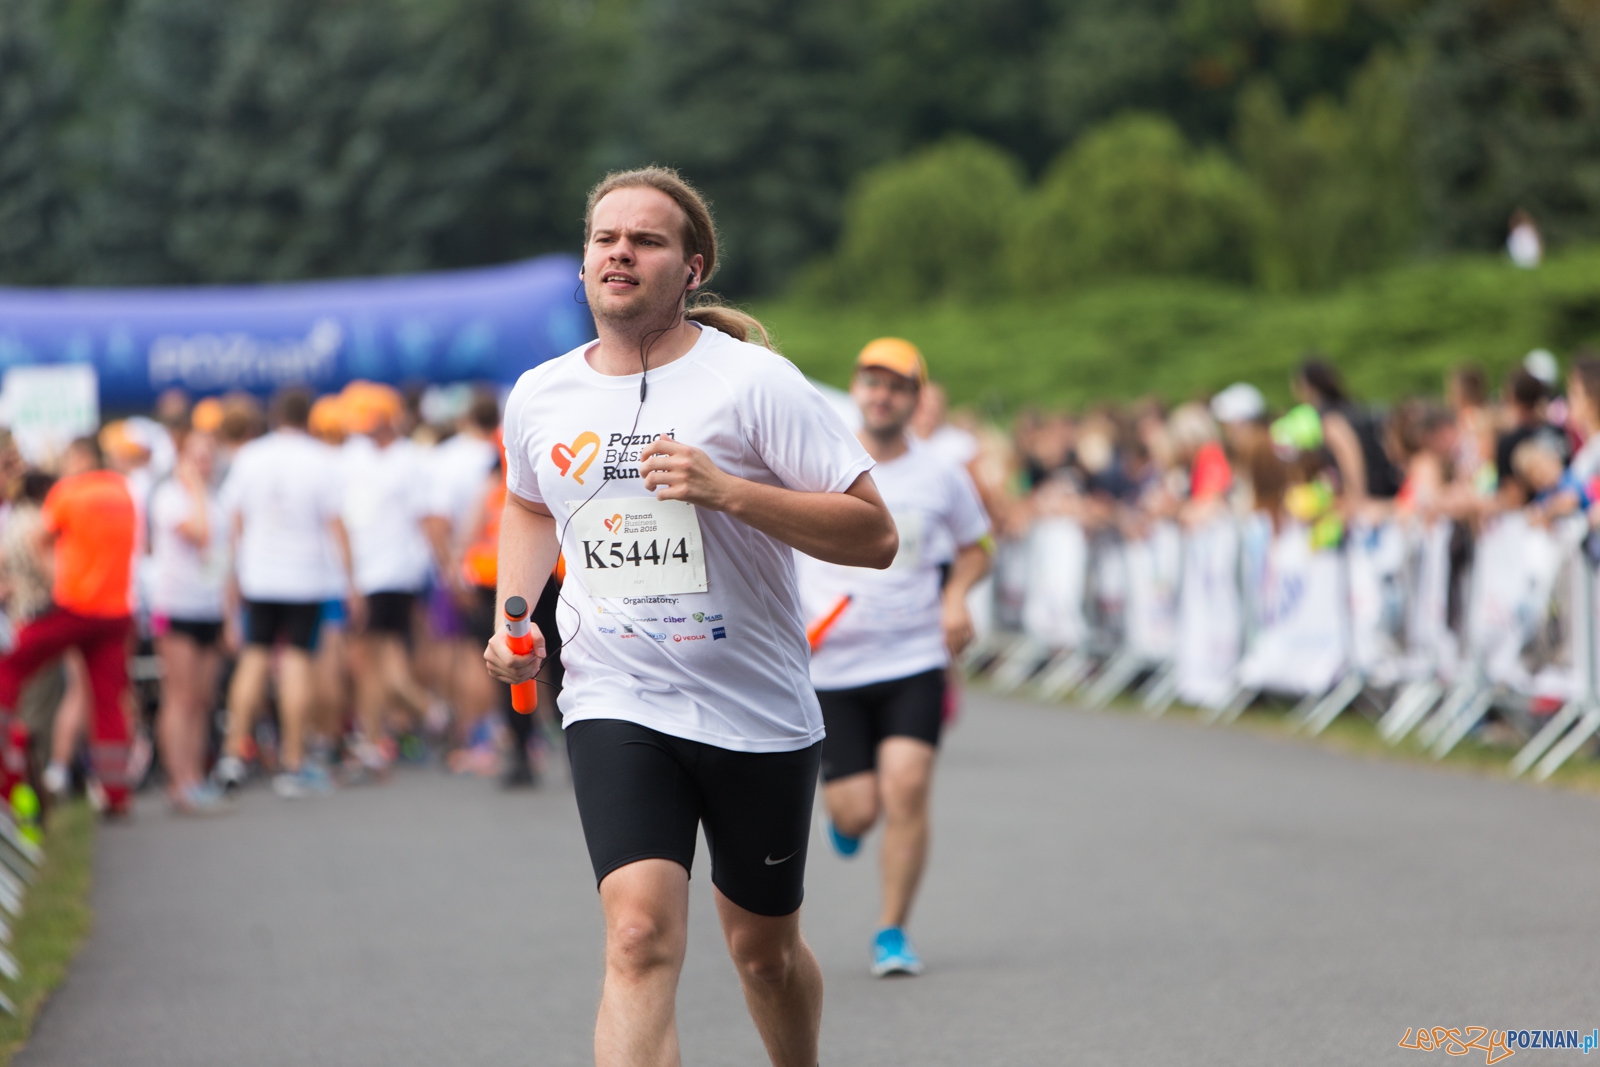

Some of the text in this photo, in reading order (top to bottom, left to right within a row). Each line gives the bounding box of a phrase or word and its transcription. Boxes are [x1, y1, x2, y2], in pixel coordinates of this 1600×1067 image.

[603, 466, 640, 480] Run
[581, 537, 689, 569] K544/4
[623, 596, 680, 606] Organizatorzy:
